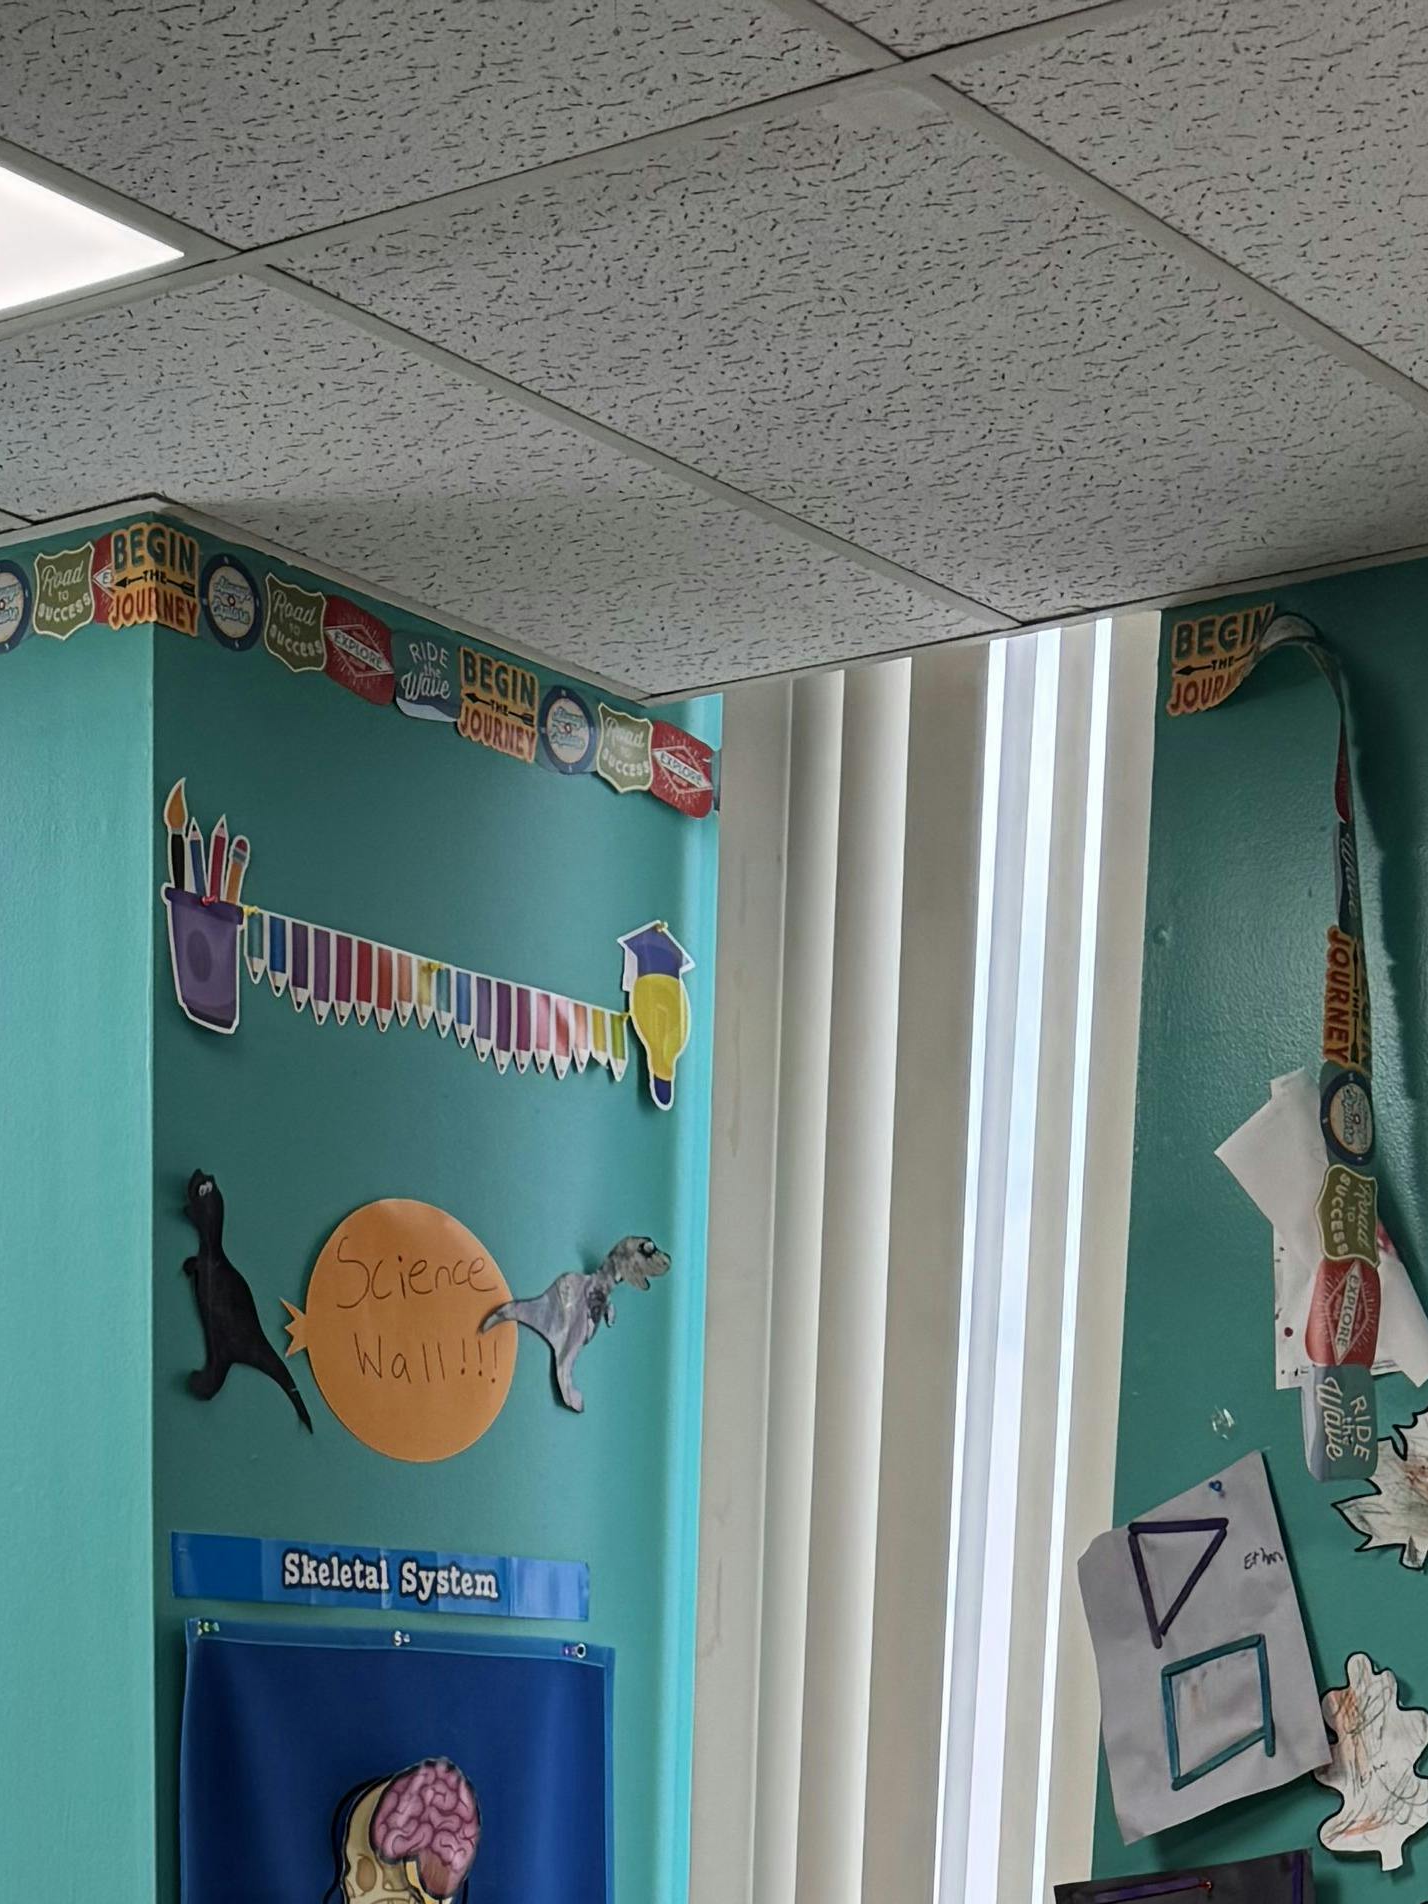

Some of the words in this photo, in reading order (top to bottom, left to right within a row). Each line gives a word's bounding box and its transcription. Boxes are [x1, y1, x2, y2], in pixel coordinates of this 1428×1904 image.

[41, 562, 83, 596] Road
[113, 526, 196, 580] BEGIN
[38, 593, 91, 622] SUCCESS
[111, 588, 198, 634] JOURNEY
[273, 591, 317, 627] Road
[1175, 606, 1271, 660] BEGIN
[270, 624, 323, 657] SUCCESS
[334, 632, 386, 669] EXPLORE
[409, 641, 449, 669] RIDE
[401, 673, 452, 700] Wave
[463, 650, 536, 711] BEGIN
[461, 706, 536, 761] JOURNEY
[602, 749, 649, 777] SUCCESS
[1327, 926, 1350, 1063] JOURNEY
[1330, 1173, 1351, 1256] SUCCESS
[1356, 1182, 1373, 1250] Road
[336, 1235, 500, 1313] Science
[1337, 1274, 1360, 1347] EXPLORE
[351, 1329, 502, 1387] Wall!!!
[1324, 1376, 1345, 1463] Wave
[1350, 1396, 1372, 1463] RIDE
[283, 1551, 391, 1595] Skeletal
[399, 1560, 502, 1602] System
